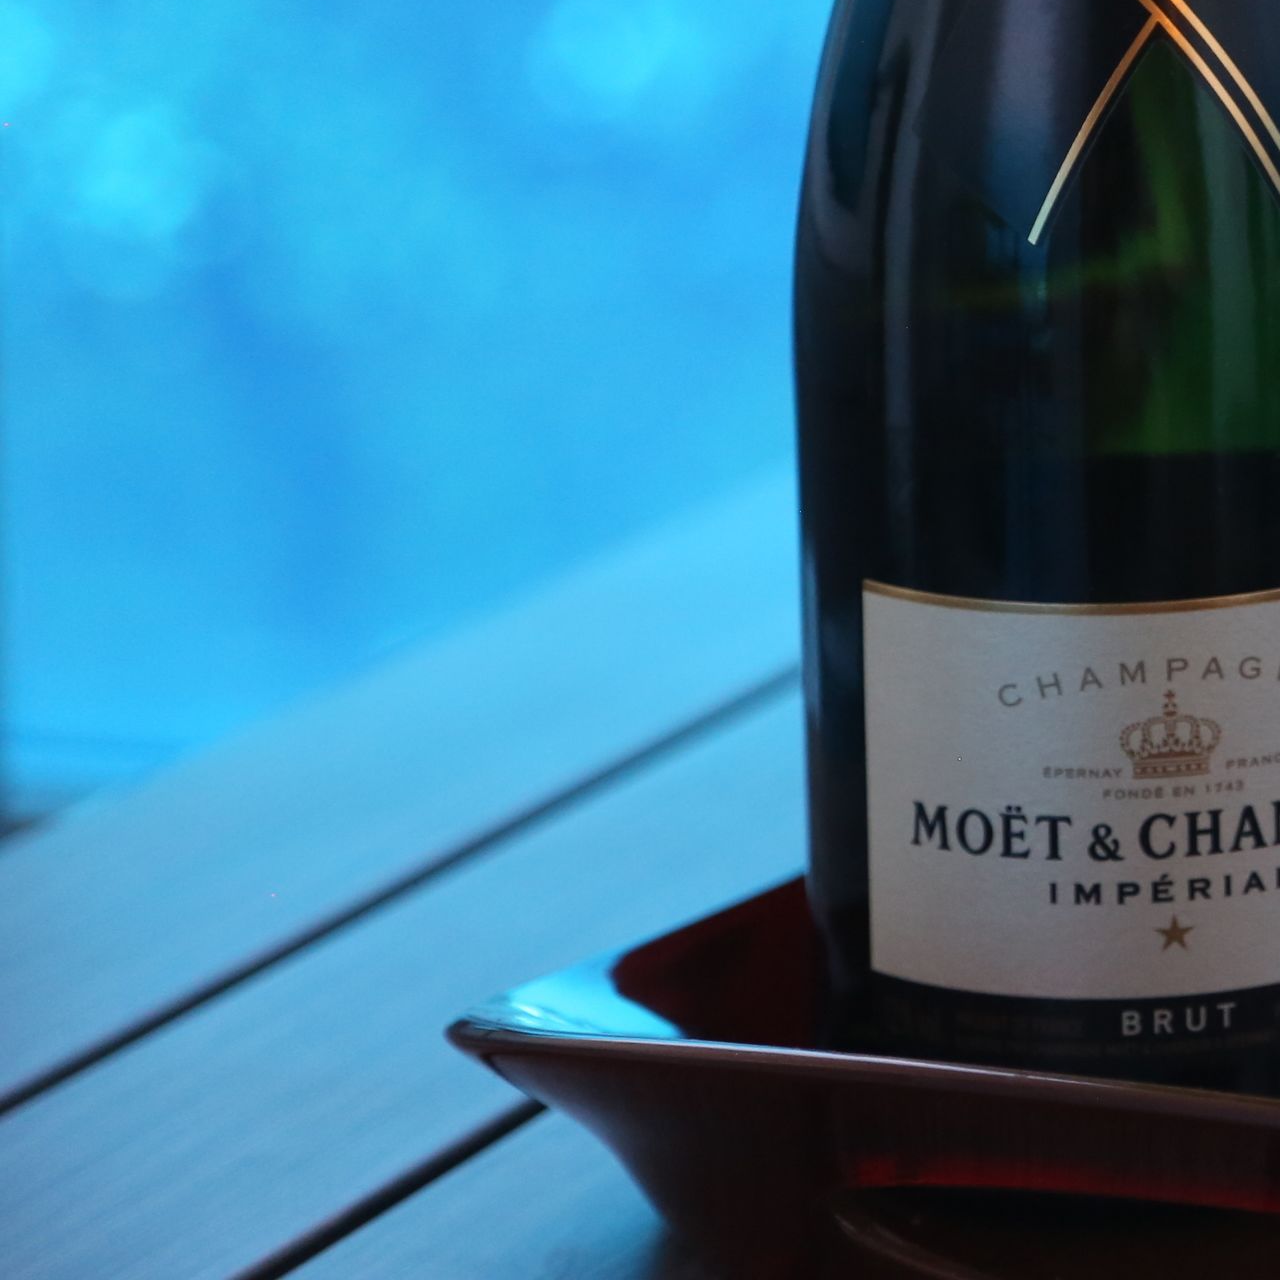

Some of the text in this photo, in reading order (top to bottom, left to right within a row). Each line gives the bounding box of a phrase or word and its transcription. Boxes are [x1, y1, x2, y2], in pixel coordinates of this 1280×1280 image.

[1042, 764, 1123, 780] ÉPERNAY
[1102, 779, 1246, 801] FONDÉ EN 1743
[911, 800, 1073, 861] MOËT
[1087, 823, 1124, 861] &
[1121, 1001, 1238, 1037] BRUT
